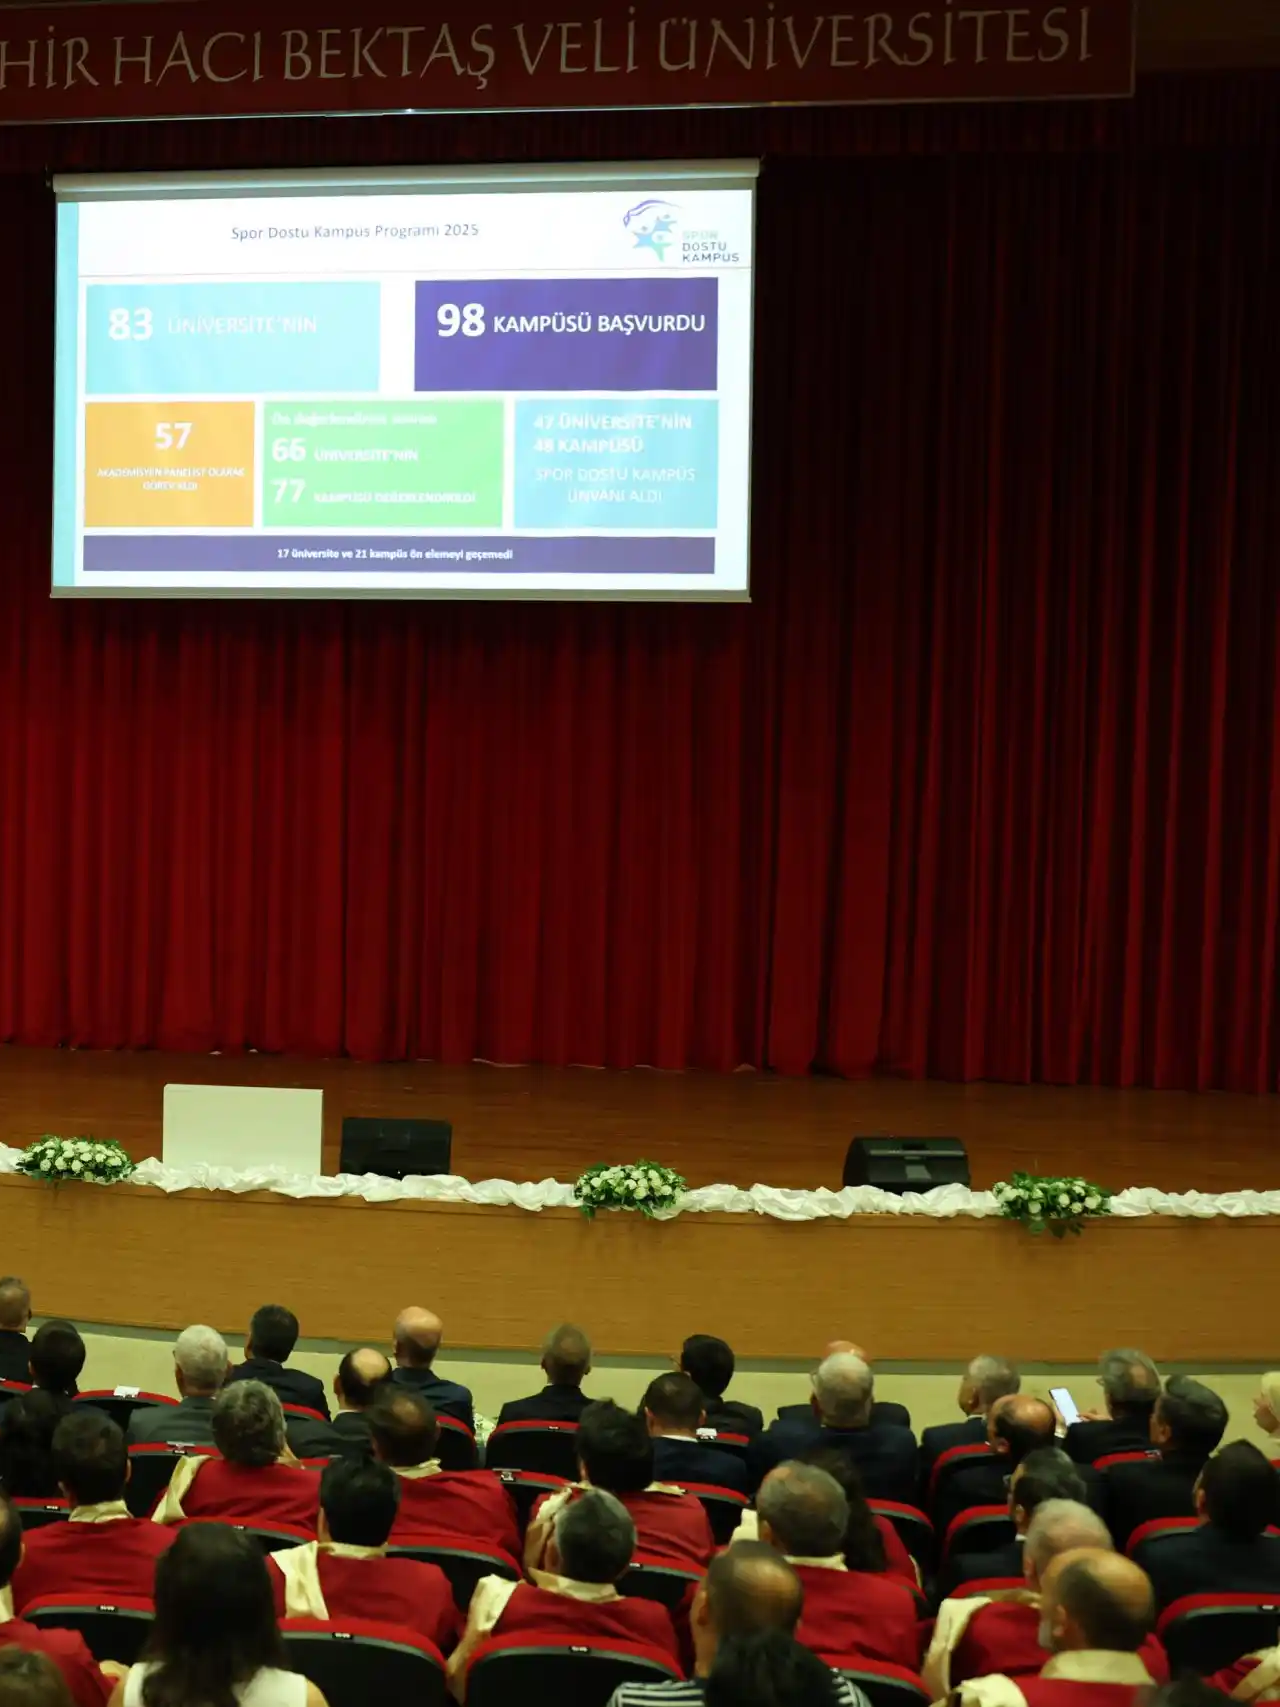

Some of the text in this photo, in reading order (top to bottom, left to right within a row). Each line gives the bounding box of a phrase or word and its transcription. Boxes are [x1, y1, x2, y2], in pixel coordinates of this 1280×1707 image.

[113, 29, 264, 87] HACI
[280, 22, 495, 90] BEKTAŞ
[511, 6, 639, 75] VELİ
[231, 227, 264, 242] Spor
[268, 226, 309, 239] Dostu
[444, 223, 479, 237] 2025
[682, 242, 727, 252] DOSTU
[108, 306, 153, 341] 83
[436, 303, 706, 337] 98 KAMPÜSÜ BAŞVURDU
[155, 422, 193, 450] 57
[271, 437, 307, 462] 66
[535, 467, 573, 482] SPOR
[577, 467, 628, 482] DOSTU
[270, 478, 307, 504] 77
[277, 549, 289, 559] 17
[341, 550, 354, 559] ve
[355, 549, 367, 559] 21
